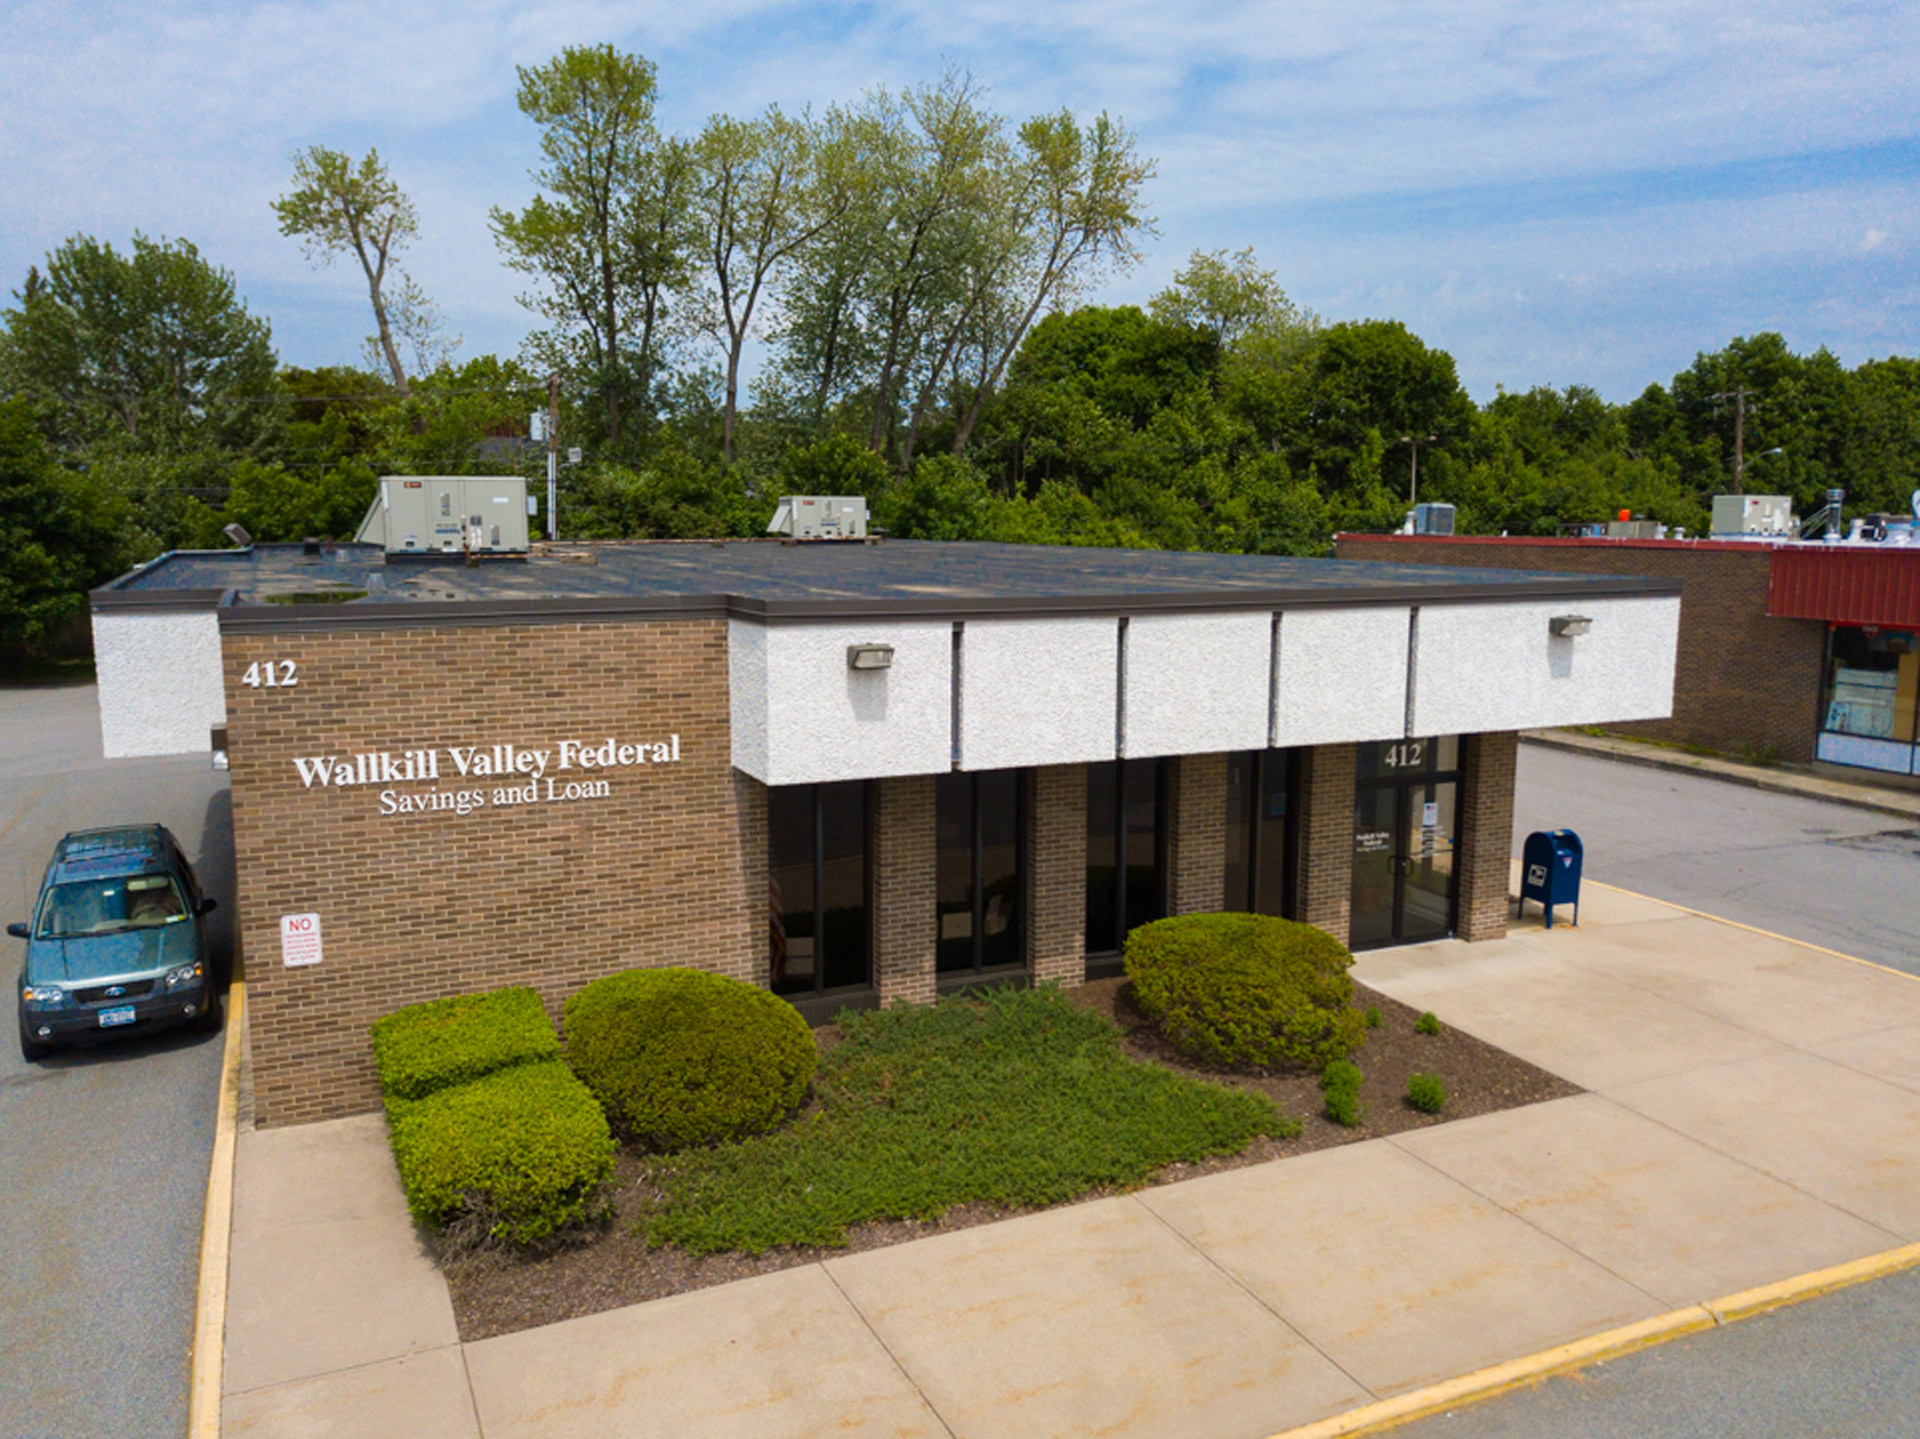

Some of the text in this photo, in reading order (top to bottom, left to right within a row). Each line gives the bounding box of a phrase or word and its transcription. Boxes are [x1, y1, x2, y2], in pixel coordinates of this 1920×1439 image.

[242, 659, 299, 688] 412
[292, 733, 681, 789] Wallkill Valley Federal
[1384, 743, 1422, 767] 412
[379, 777, 611, 815] Savings and Loan
[289, 917, 312, 932] NO
